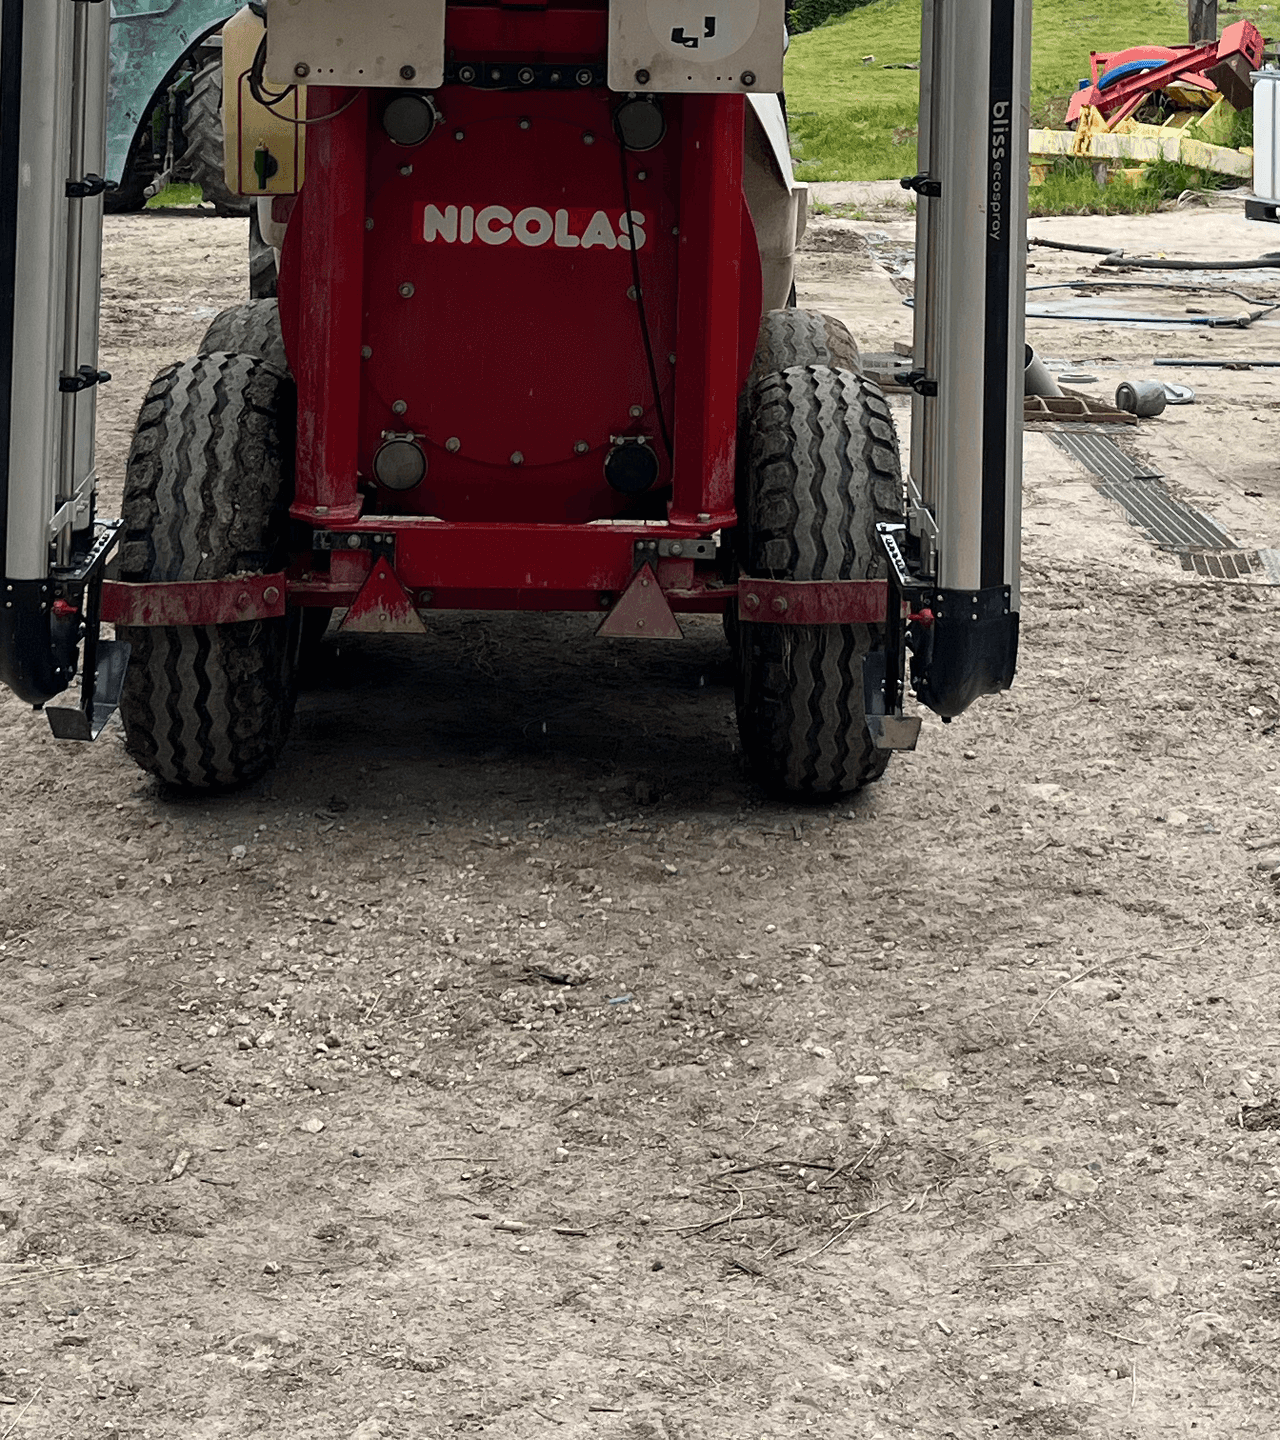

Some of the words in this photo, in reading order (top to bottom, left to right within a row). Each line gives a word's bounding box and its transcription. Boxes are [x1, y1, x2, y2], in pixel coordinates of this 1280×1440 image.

[992, 101, 1009, 160] bliss
[423, 203, 647, 251] NICOLAS
[989, 161, 1002, 241] ecospray
